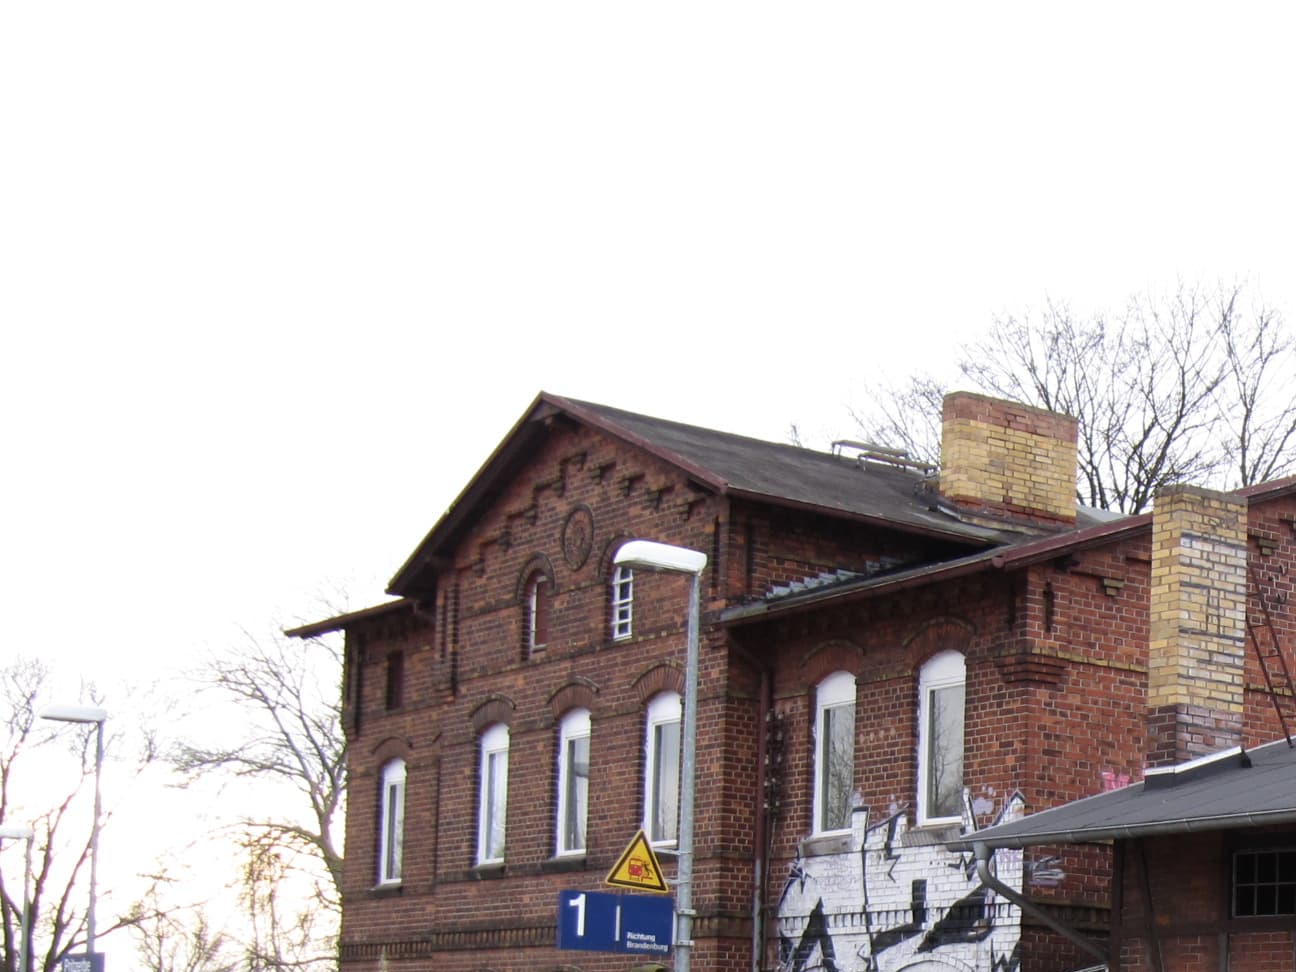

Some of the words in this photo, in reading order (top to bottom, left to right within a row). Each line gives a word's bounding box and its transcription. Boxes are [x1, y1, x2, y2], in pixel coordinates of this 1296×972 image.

[568, 893, 587, 937] 1
[626, 931, 656, 942] Richtung
[626, 941, 669, 953] Brandenburg
